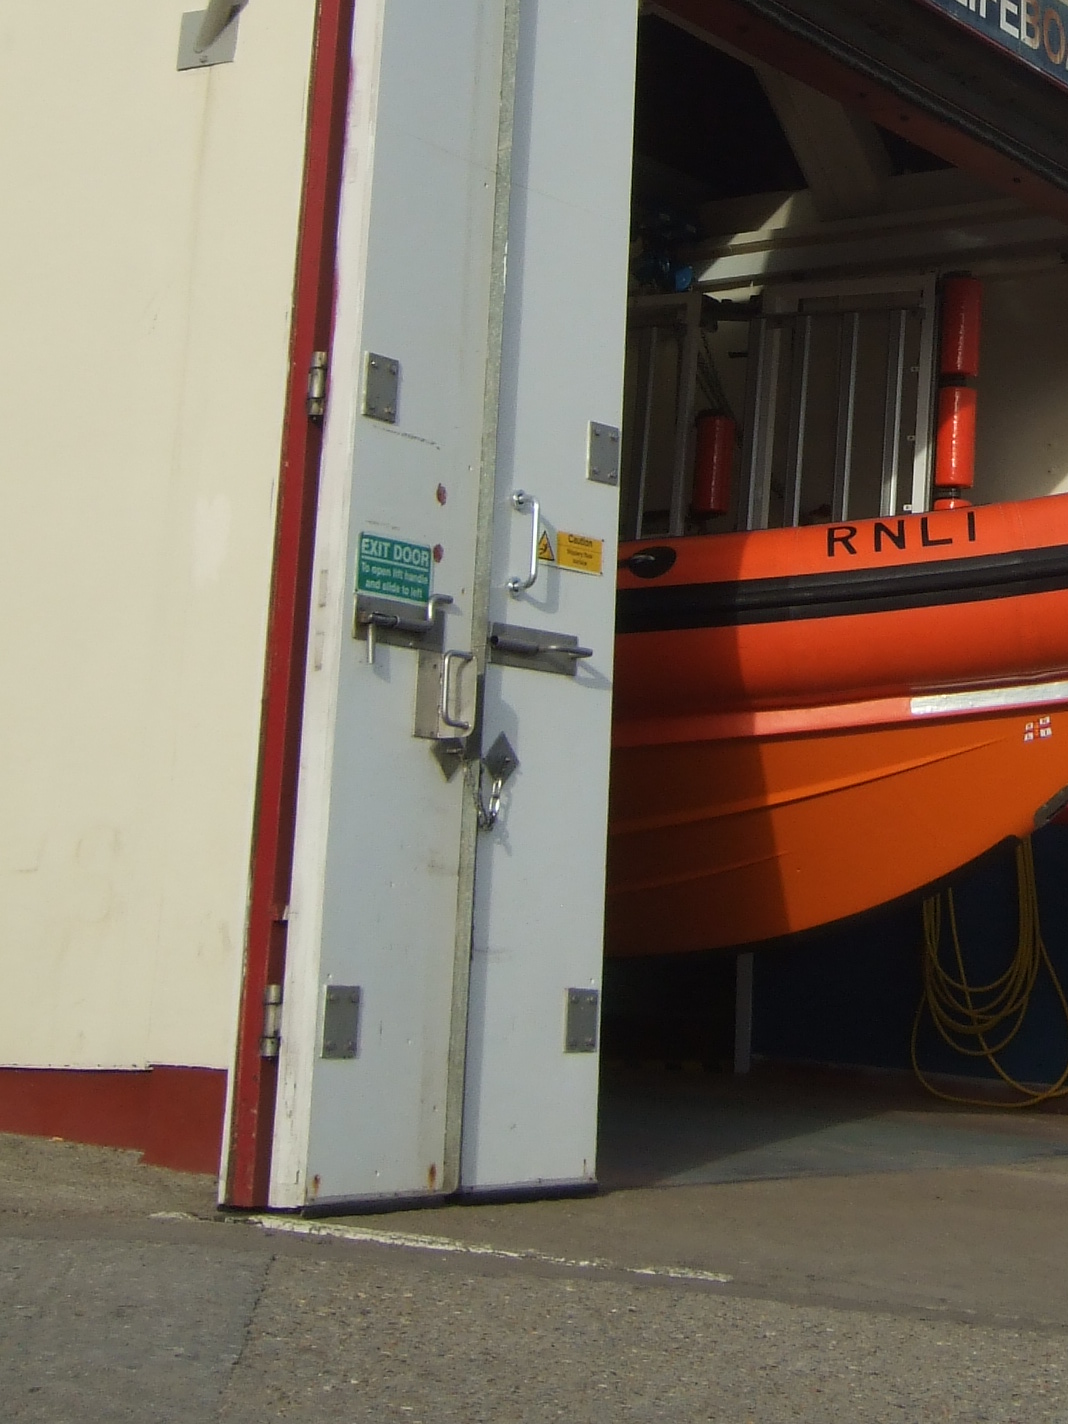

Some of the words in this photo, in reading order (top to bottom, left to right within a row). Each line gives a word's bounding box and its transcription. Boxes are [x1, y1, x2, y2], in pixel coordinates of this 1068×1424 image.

[361, 538, 391, 558] EXIT
[393, 544, 429, 567] DOOR
[827, 511, 976, 557] RNLI
